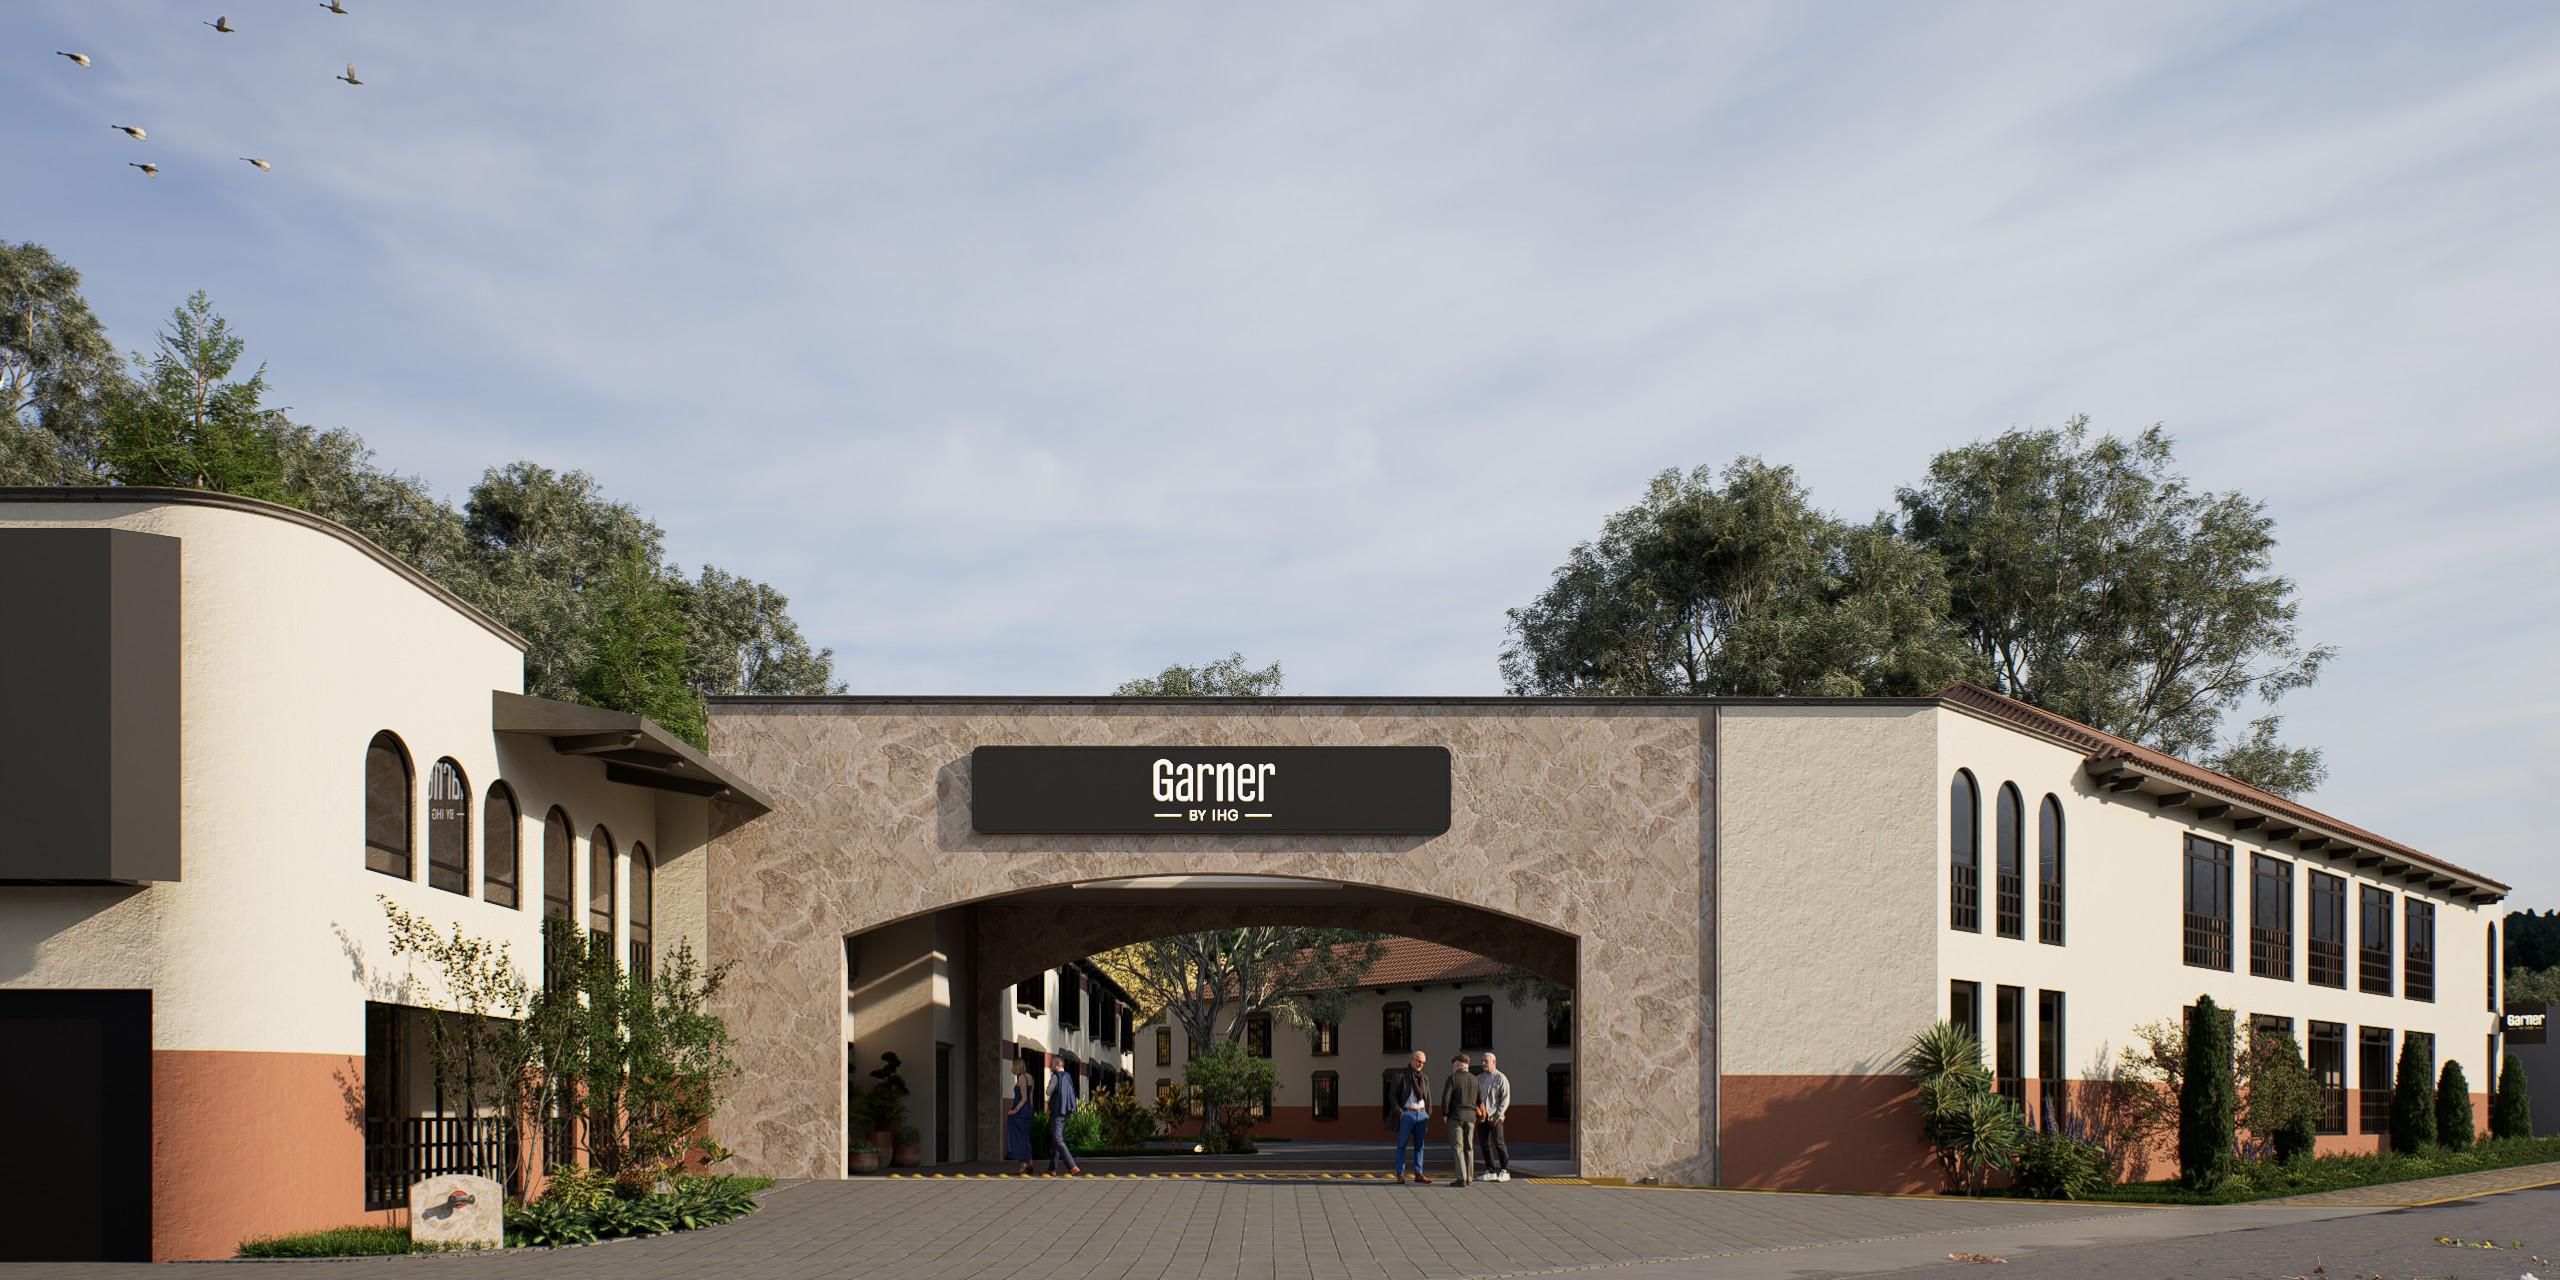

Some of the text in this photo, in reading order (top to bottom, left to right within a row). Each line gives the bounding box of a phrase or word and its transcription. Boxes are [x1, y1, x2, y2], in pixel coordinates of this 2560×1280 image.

[1152, 758, 1276, 802] Garner
[1188, 808, 1239, 821] BY IHG
[2507, 1014, 2545, 1026] Garner
